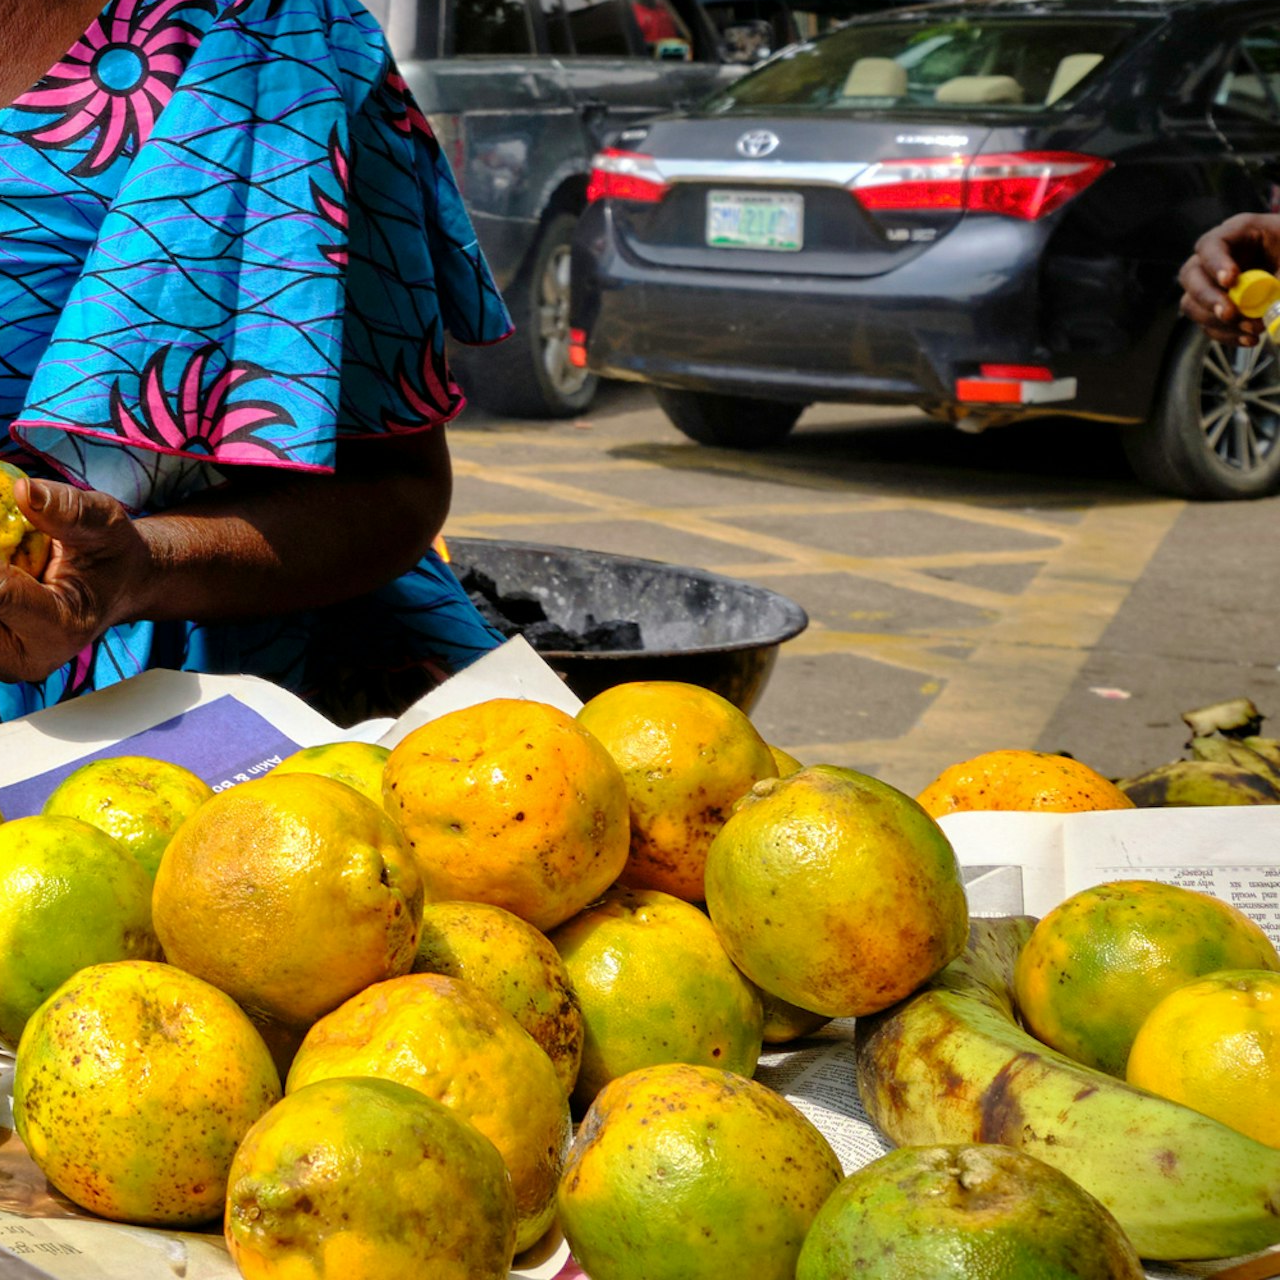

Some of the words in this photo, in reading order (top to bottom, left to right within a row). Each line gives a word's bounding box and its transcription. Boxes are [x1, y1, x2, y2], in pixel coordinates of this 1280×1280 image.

[246, 753, 283, 777] Akin
[234, 771, 246, 784] &
[1196, 877, 1214, 888] why
[1229, 881, 1241, 889] six
[1231, 892, 1256, 900] would
